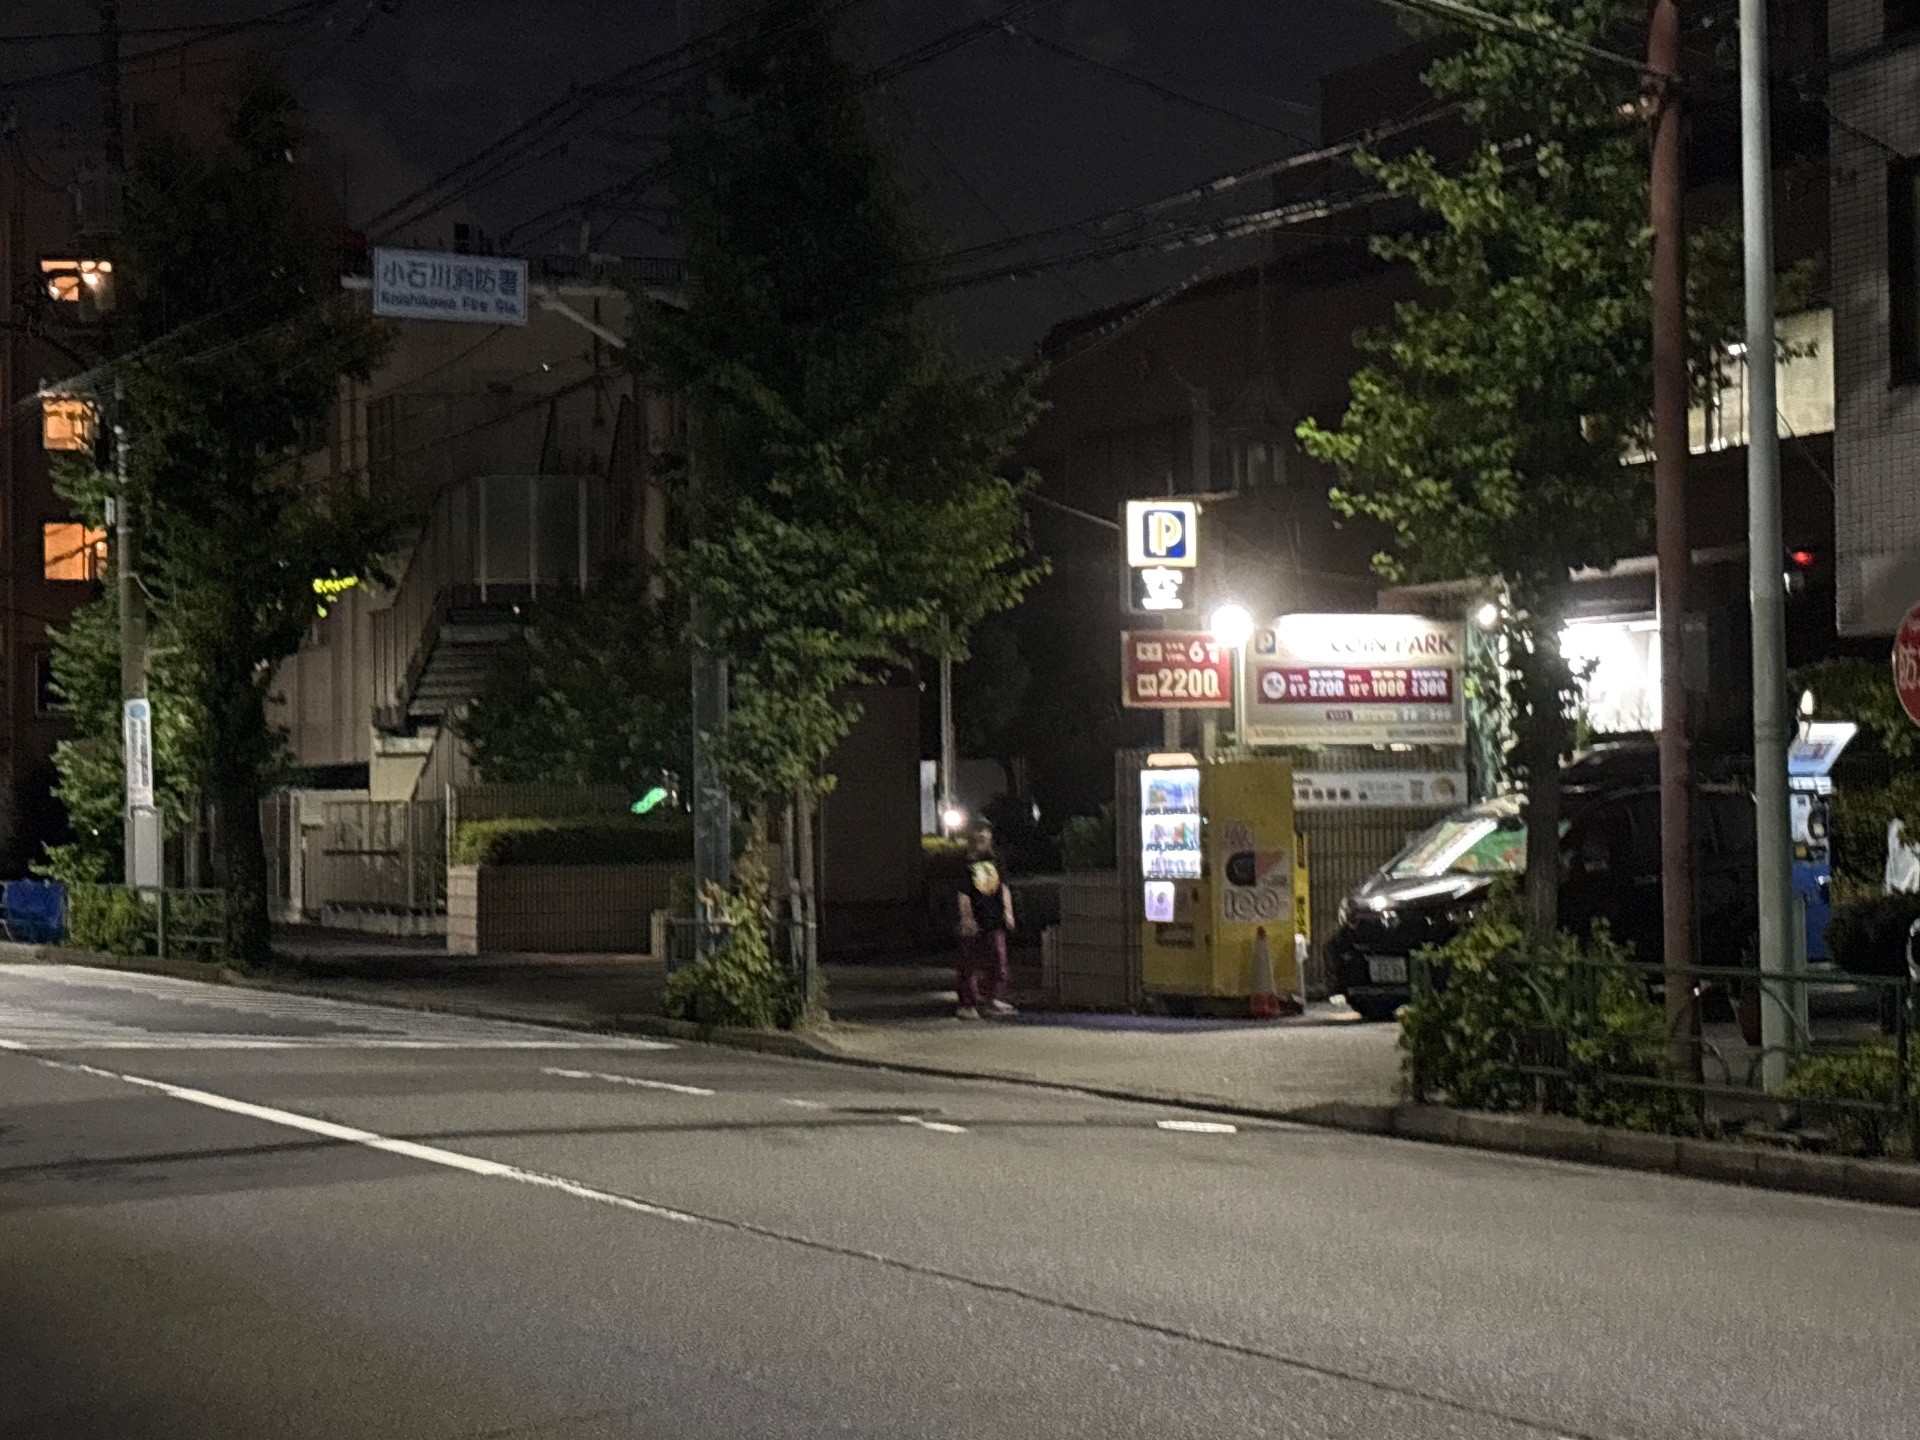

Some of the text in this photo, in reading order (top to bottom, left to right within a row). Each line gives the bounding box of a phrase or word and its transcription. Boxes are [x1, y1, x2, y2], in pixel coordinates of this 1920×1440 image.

[382, 260, 518, 295] 小石川消防署
[1331, 636, 1387, 653] IN
